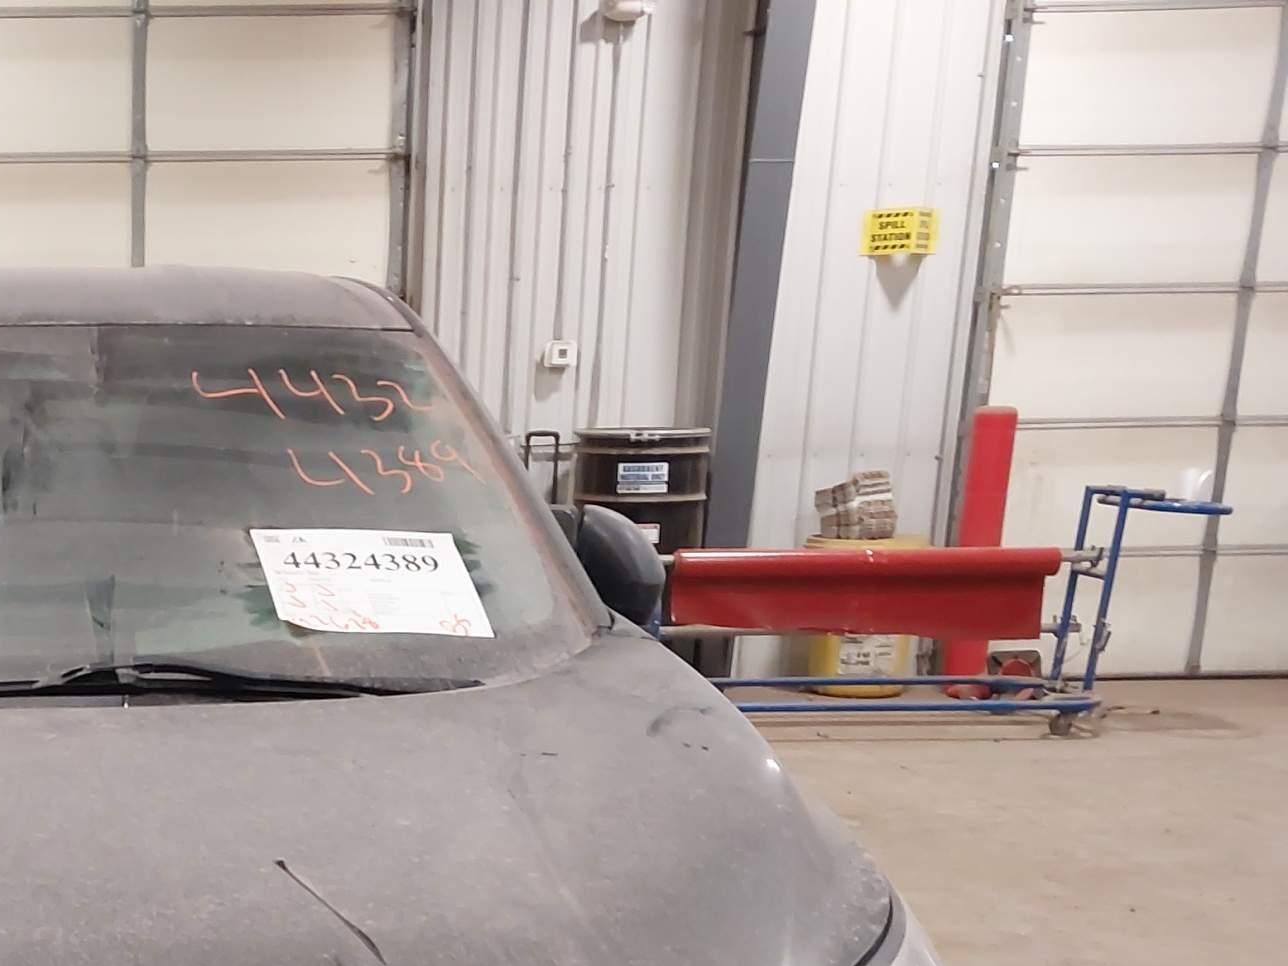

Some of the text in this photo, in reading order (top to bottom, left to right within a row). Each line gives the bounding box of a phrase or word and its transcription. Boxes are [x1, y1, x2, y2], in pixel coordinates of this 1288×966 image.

[878, 220, 906, 229] SPILL
[871, 232, 911, 242] STATION
[283, 551, 439, 573] 44324389
